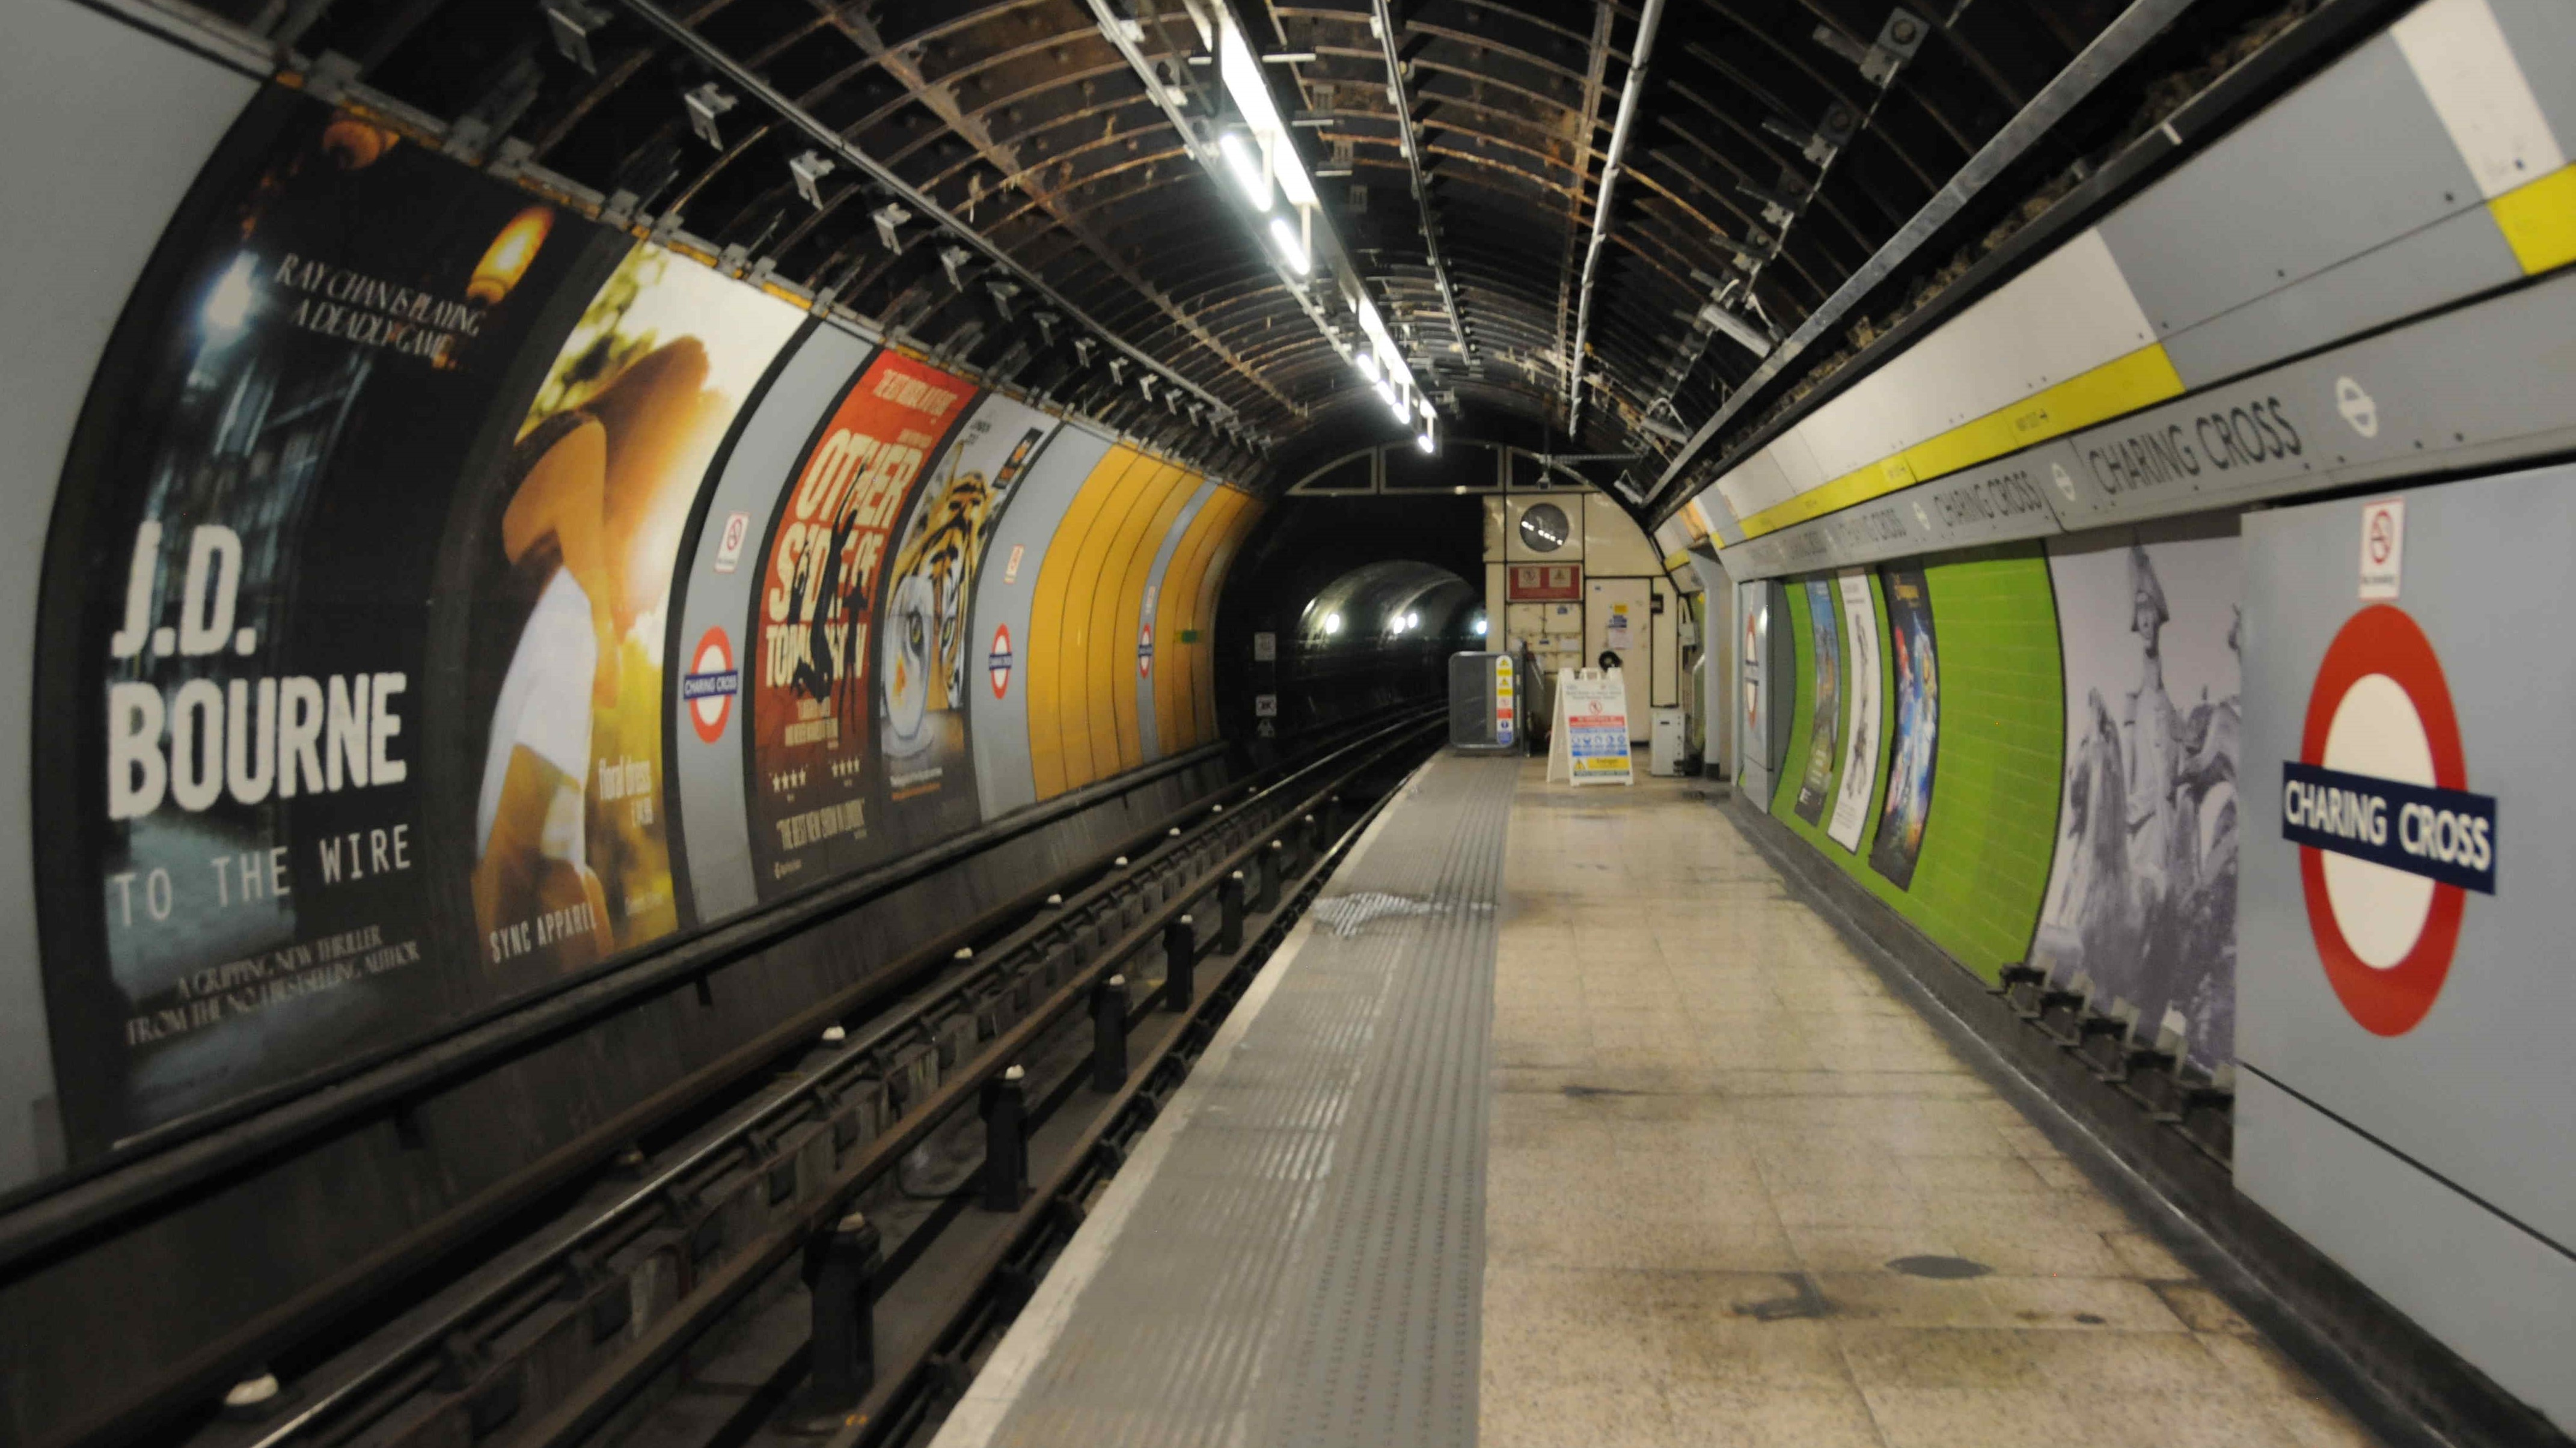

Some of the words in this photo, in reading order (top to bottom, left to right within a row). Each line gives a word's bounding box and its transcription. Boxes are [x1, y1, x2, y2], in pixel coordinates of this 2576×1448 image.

[275, 252, 328, 293] RAY
[326, 270, 392, 310] CHAN
[409, 292, 485, 338] PLAYING
[292, 298, 311, 328] A
[309, 301, 397, 347] DEADLY
[795, 428, 923, 529] OTHER
[2088, 424, 2201, 495] CHARING
[2195, 396, 2302, 470] CROSS
[111, 520, 257, 659] J.D.
[107, 671, 408, 820] BOURNE
[2283, 780, 2388, 846] CHARING
[2398, 801, 2492, 872] CROSS
[114, 867, 174, 929] TO
[210, 846, 292, 909] THE
[318, 823, 412, 885] WIRE
[489, 920, 532, 964] SYNC
